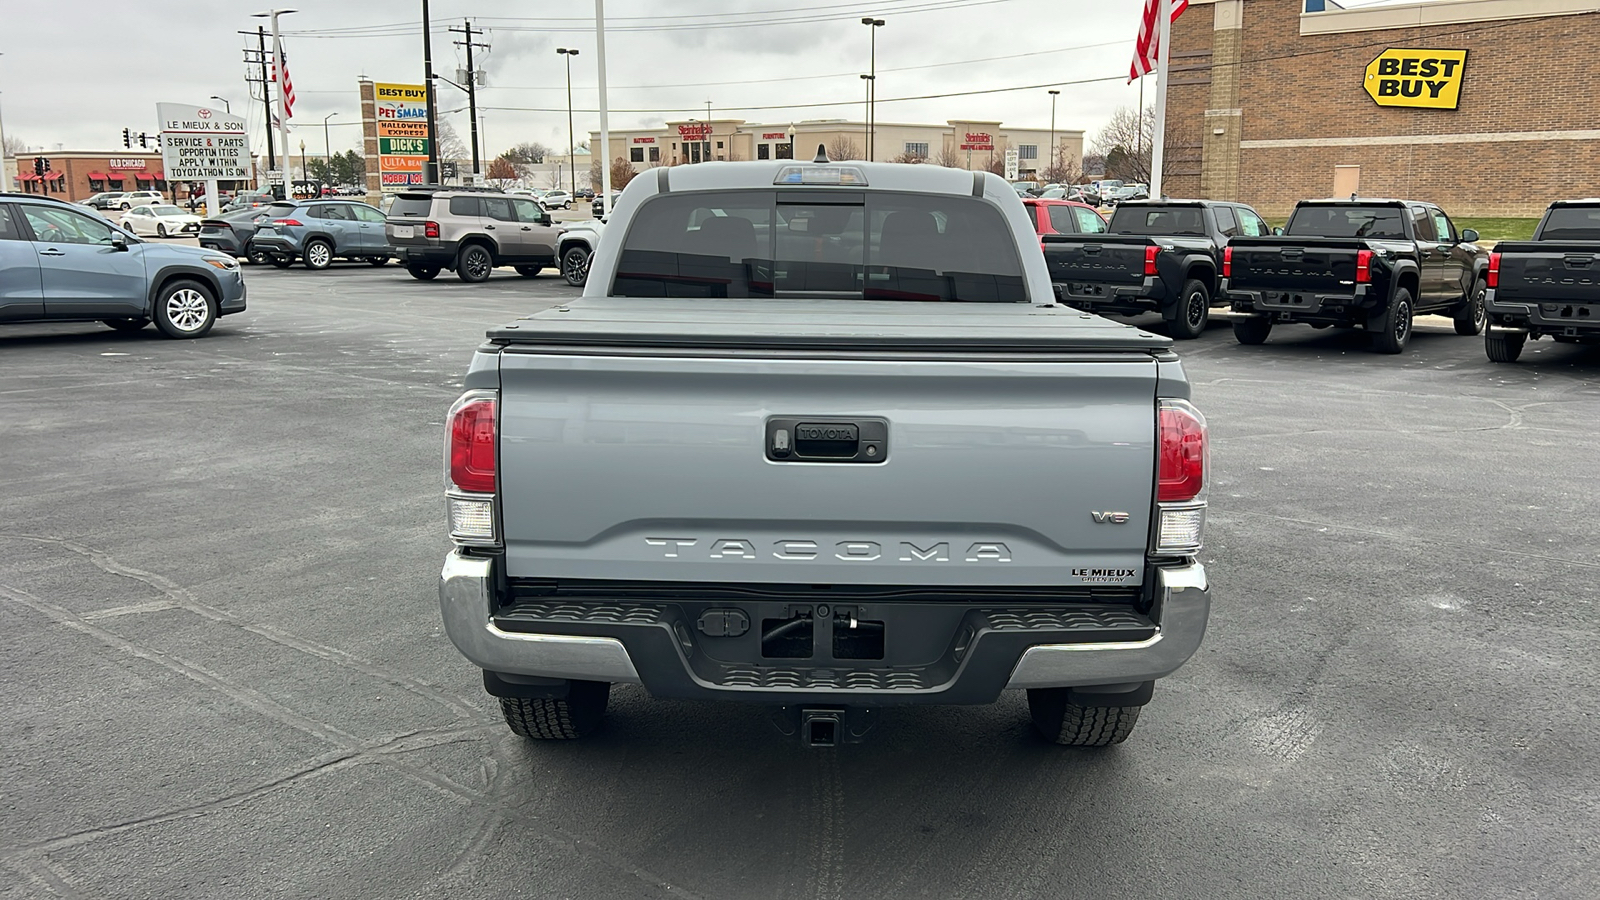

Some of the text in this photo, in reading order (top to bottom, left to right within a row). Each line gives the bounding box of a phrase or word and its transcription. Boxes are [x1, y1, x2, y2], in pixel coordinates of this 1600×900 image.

[1378, 58, 1460, 78] BEST
[379, 88, 425, 98] BEST BUY
[1378, 80, 1449, 98] BUY
[168, 138, 244, 147] SERVICE & PARTS
[390, 139, 423, 151] DICK'S
[180, 148, 238, 157] OPPORTUNITIES
[110, 159, 145, 167] OLD CHICAGO
[179, 158, 204, 166] APPLY
[384, 158, 406, 166] ULTA
[171, 168, 223, 176] TOYOTATHON
[383, 174, 407, 184] HOBBY
[1250, 268, 1334, 276] TACOMA
[1524, 278, 1600, 286] TACO
[800, 426, 854, 440] TOYOTA
[1091, 511, 1129, 524] V6
[645, 537, 1011, 562] TACOMA
